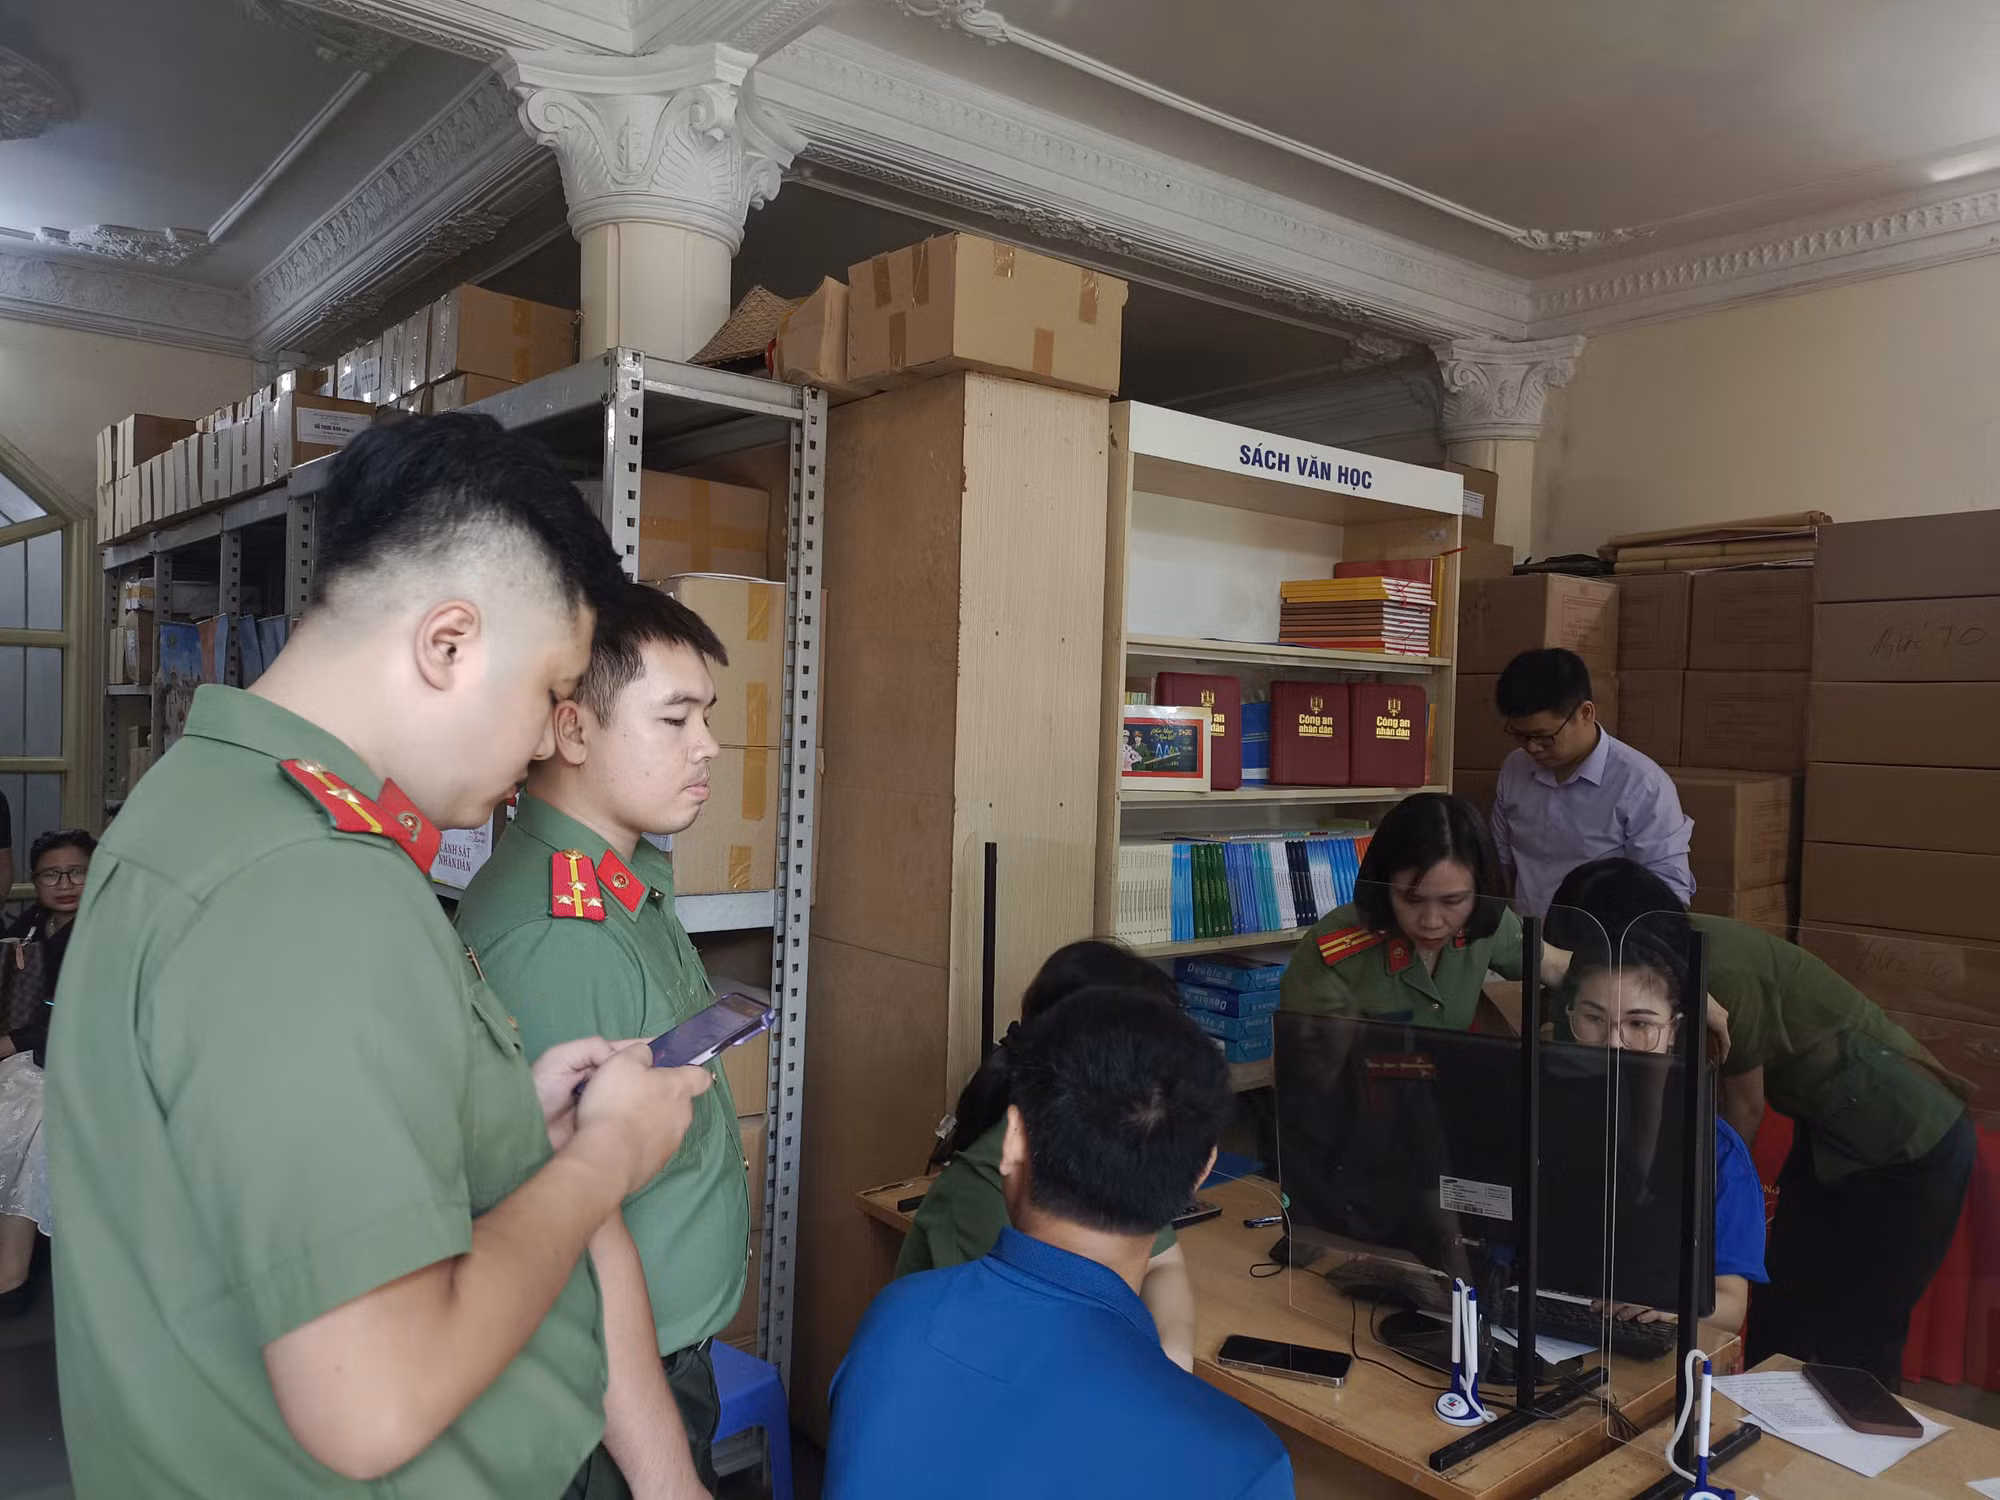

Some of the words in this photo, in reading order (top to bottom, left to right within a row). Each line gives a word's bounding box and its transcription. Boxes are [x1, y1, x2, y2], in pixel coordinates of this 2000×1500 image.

[1239, 442, 1290, 473] SÁCH
[1296, 455, 1332, 481] VĂN
[1337, 465, 1373, 491] HỌC
[1298, 714, 1321, 726] Công
[1322, 717, 1333, 726] an
[1376, 716, 1398, 728] Công
[1399, 719, 1411, 728] an
[1318, 725, 1333, 735] dân
[1395, 728, 1411, 737] dân
[1187, 963, 1222, 978] Double
[1761, 1184, 1781, 1195] NG
